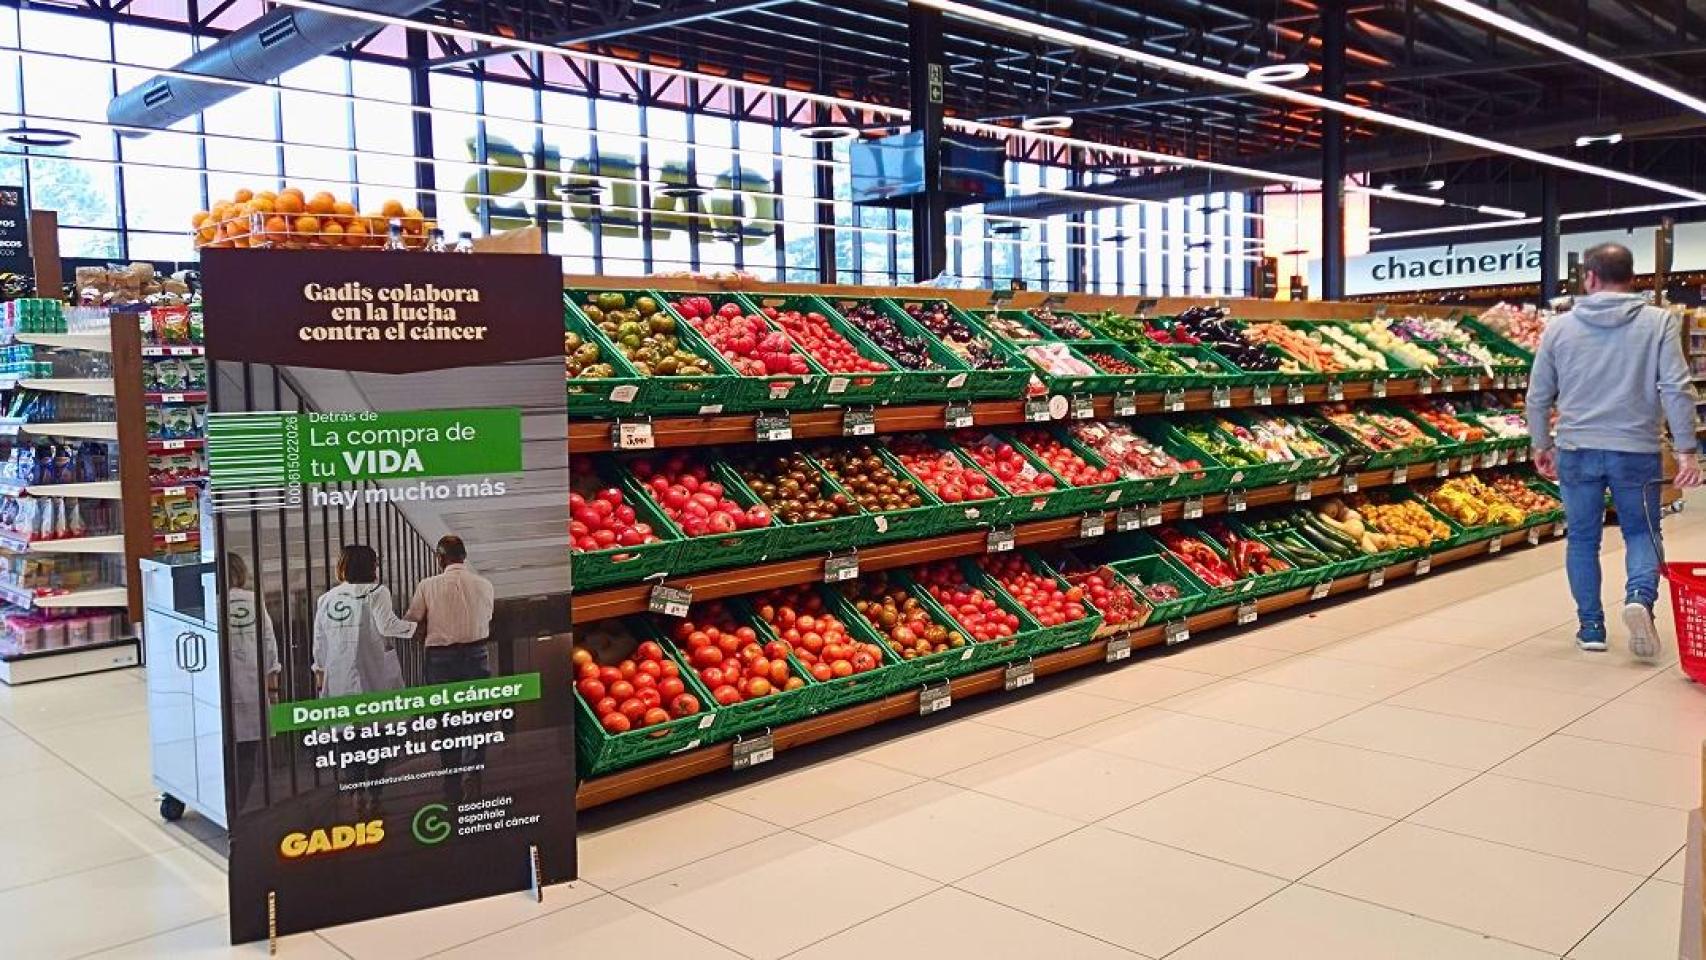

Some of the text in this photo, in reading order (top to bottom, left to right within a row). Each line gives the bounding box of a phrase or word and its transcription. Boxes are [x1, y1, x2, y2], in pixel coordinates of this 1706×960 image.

[1372, 244, 1541, 281] chacinería
[303, 281, 480, 302] Gadis colabora
[331, 302, 457, 321] en la lucha
[299, 321, 487, 341] contra el cáncer
[308, 410, 379, 423] Detrás de
[310, 421, 476, 448] La compra de
[310, 448, 425, 477] tu VIDA
[311, 478, 507, 510] hay mucho más
[292, 682, 524, 724] Dona contra el cáncer
[303, 707, 515, 747] del 6 al 15 de febrero
[315, 730, 506, 769] al pagar tu compra
[457, 796, 513, 812] asociación
[457, 808, 506, 824] española
[280, 819, 386, 858] GADIS
[457, 814, 541, 836] contra el cáncer
